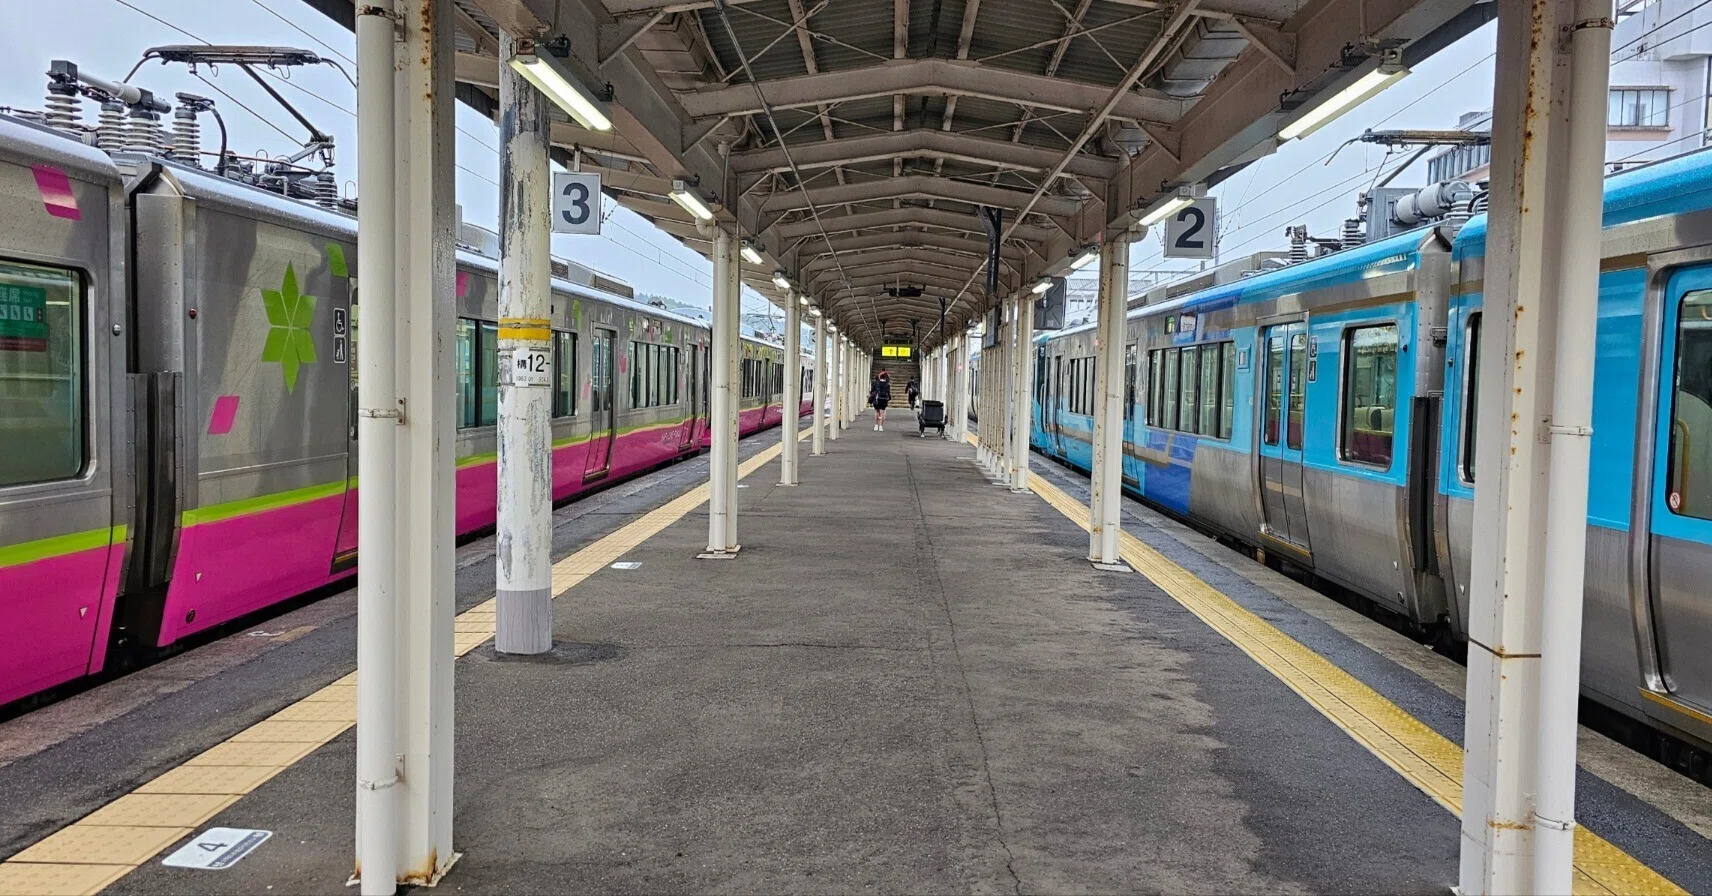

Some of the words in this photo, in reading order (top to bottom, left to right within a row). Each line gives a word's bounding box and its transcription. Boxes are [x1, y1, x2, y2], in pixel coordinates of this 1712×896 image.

[562, 182, 590, 225] 3
[1174, 206, 1205, 248] 2
[197, 843, 228, 852] 4
